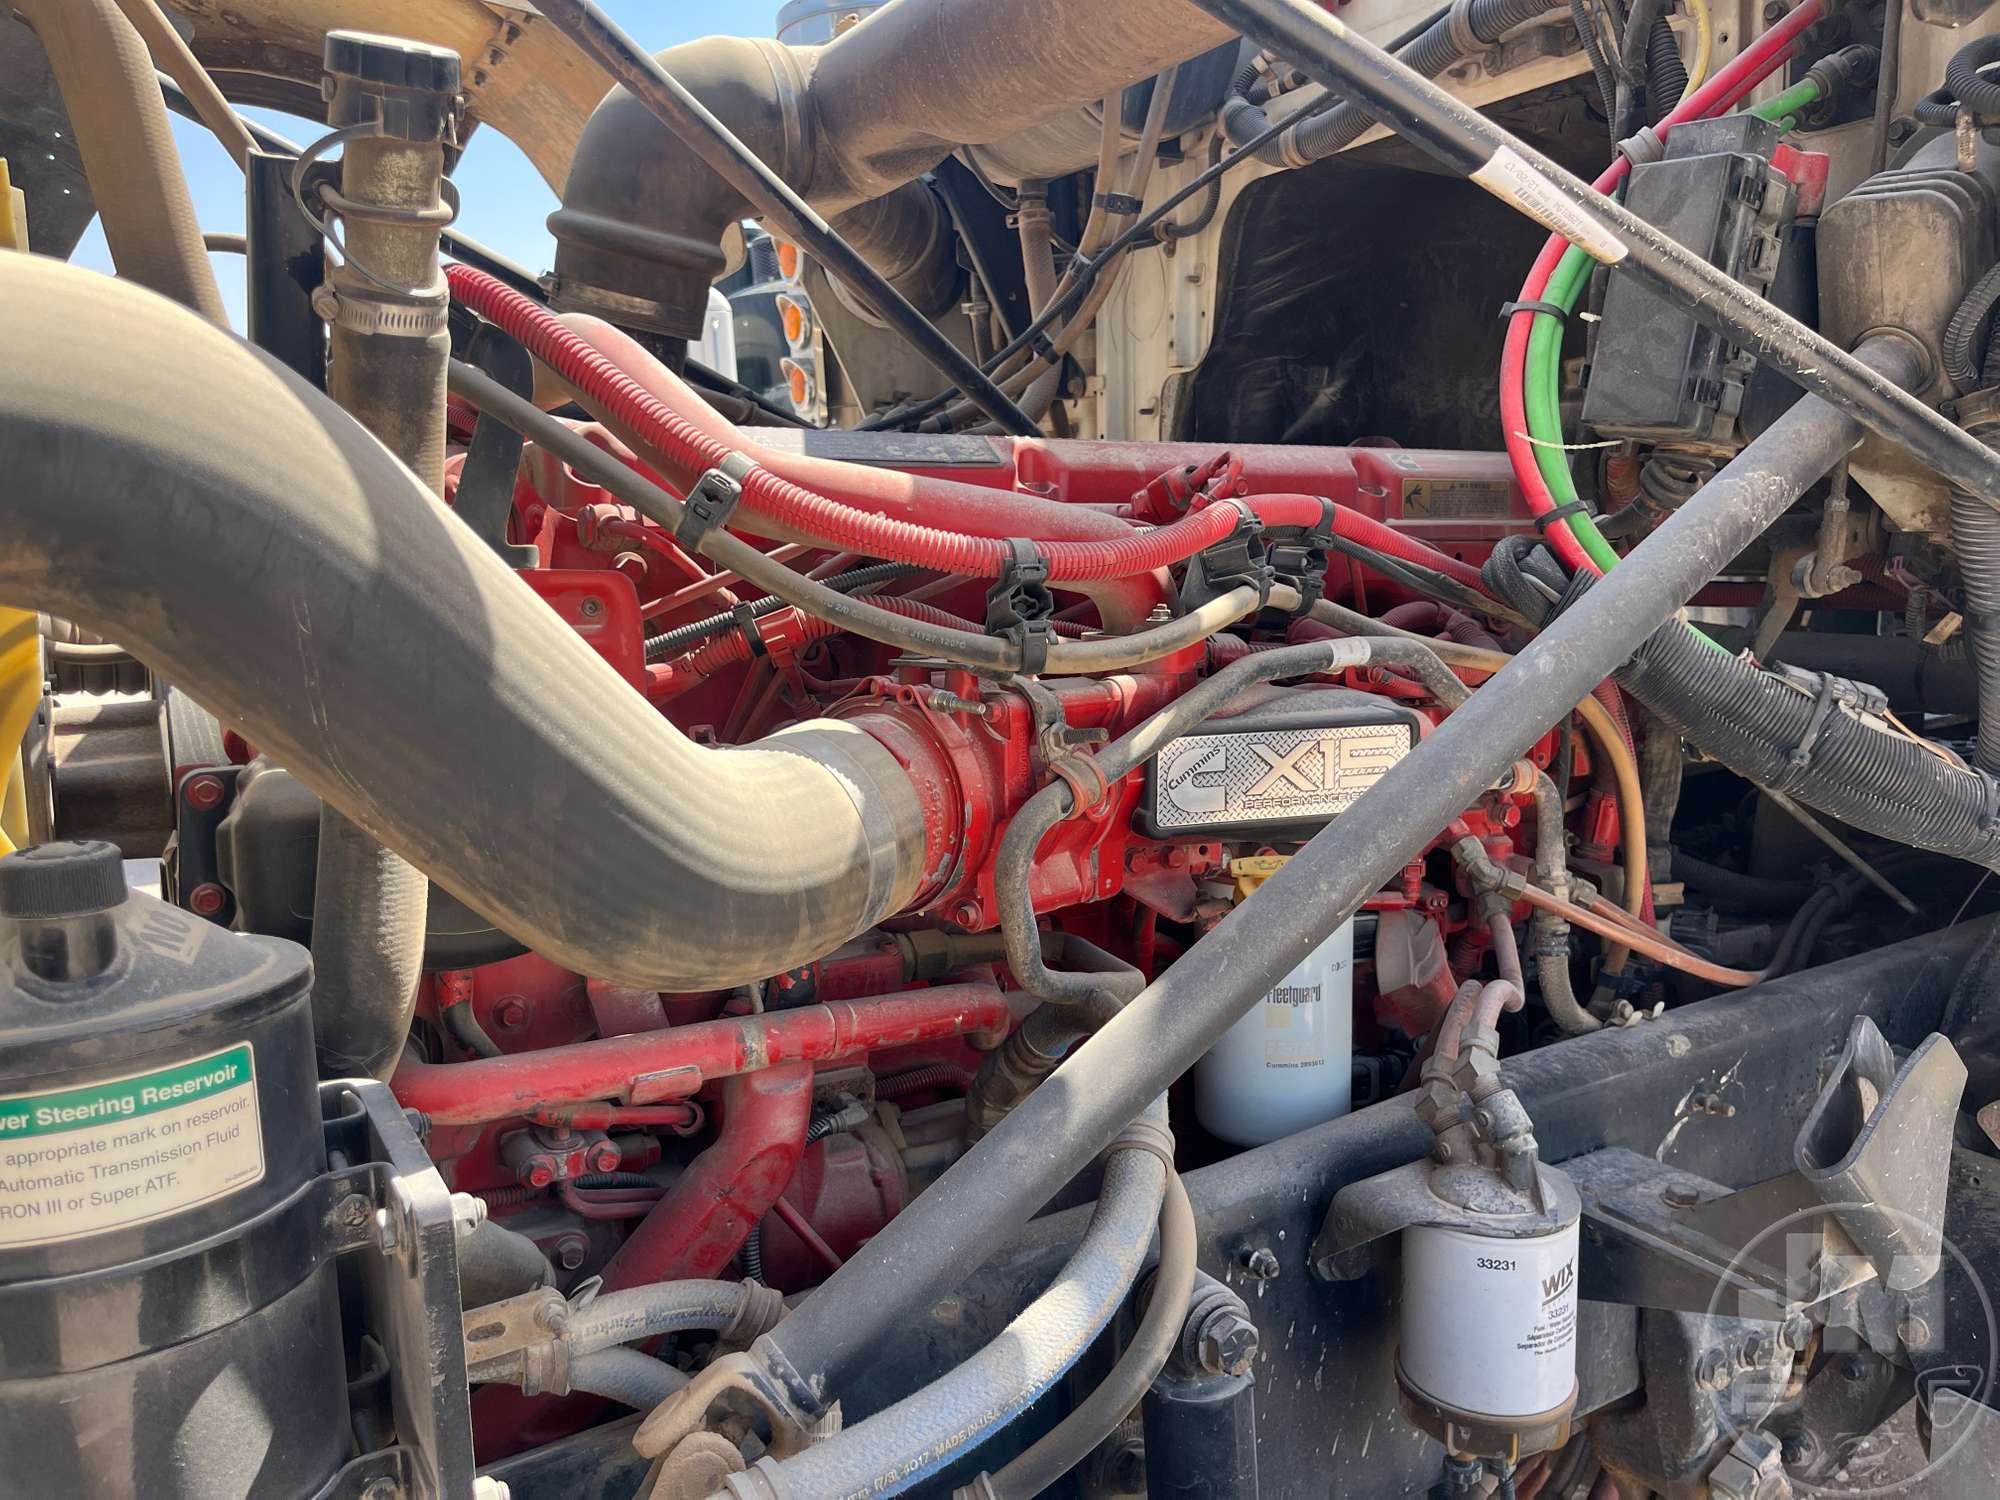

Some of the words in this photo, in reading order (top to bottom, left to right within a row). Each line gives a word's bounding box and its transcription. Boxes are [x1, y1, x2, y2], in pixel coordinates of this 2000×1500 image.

[1167, 744, 1222, 792] Cummins
[1243, 735, 1406, 797] X15
[1243, 792, 1348, 810] PERFORMANCE
[36, 1094, 135, 1128] Steering
[141, 1063, 238, 1106] Reservoir
[6, 1139, 107, 1168] appropriate
[112, 1127, 157, 1150] mark
[161, 1121, 183, 1138] on
[186, 1095, 250, 1127] reservoir.
[0, 1169, 85, 1195] Automatic
[89, 1140, 202, 1181] Transmission
[206, 1124, 241, 1149] Fluid
[0, 1201, 41, 1221] RON
[47, 1199, 63, 1215] III
[67, 1196, 86, 1211] or
[90, 1184, 141, 1210] Super
[145, 1172, 181, 1194] ATF.
[1476, 1257, 1517, 1271] 33231
[1541, 1256, 1574, 1298] WIX
[933, 1429, 967, 1458] MADE
